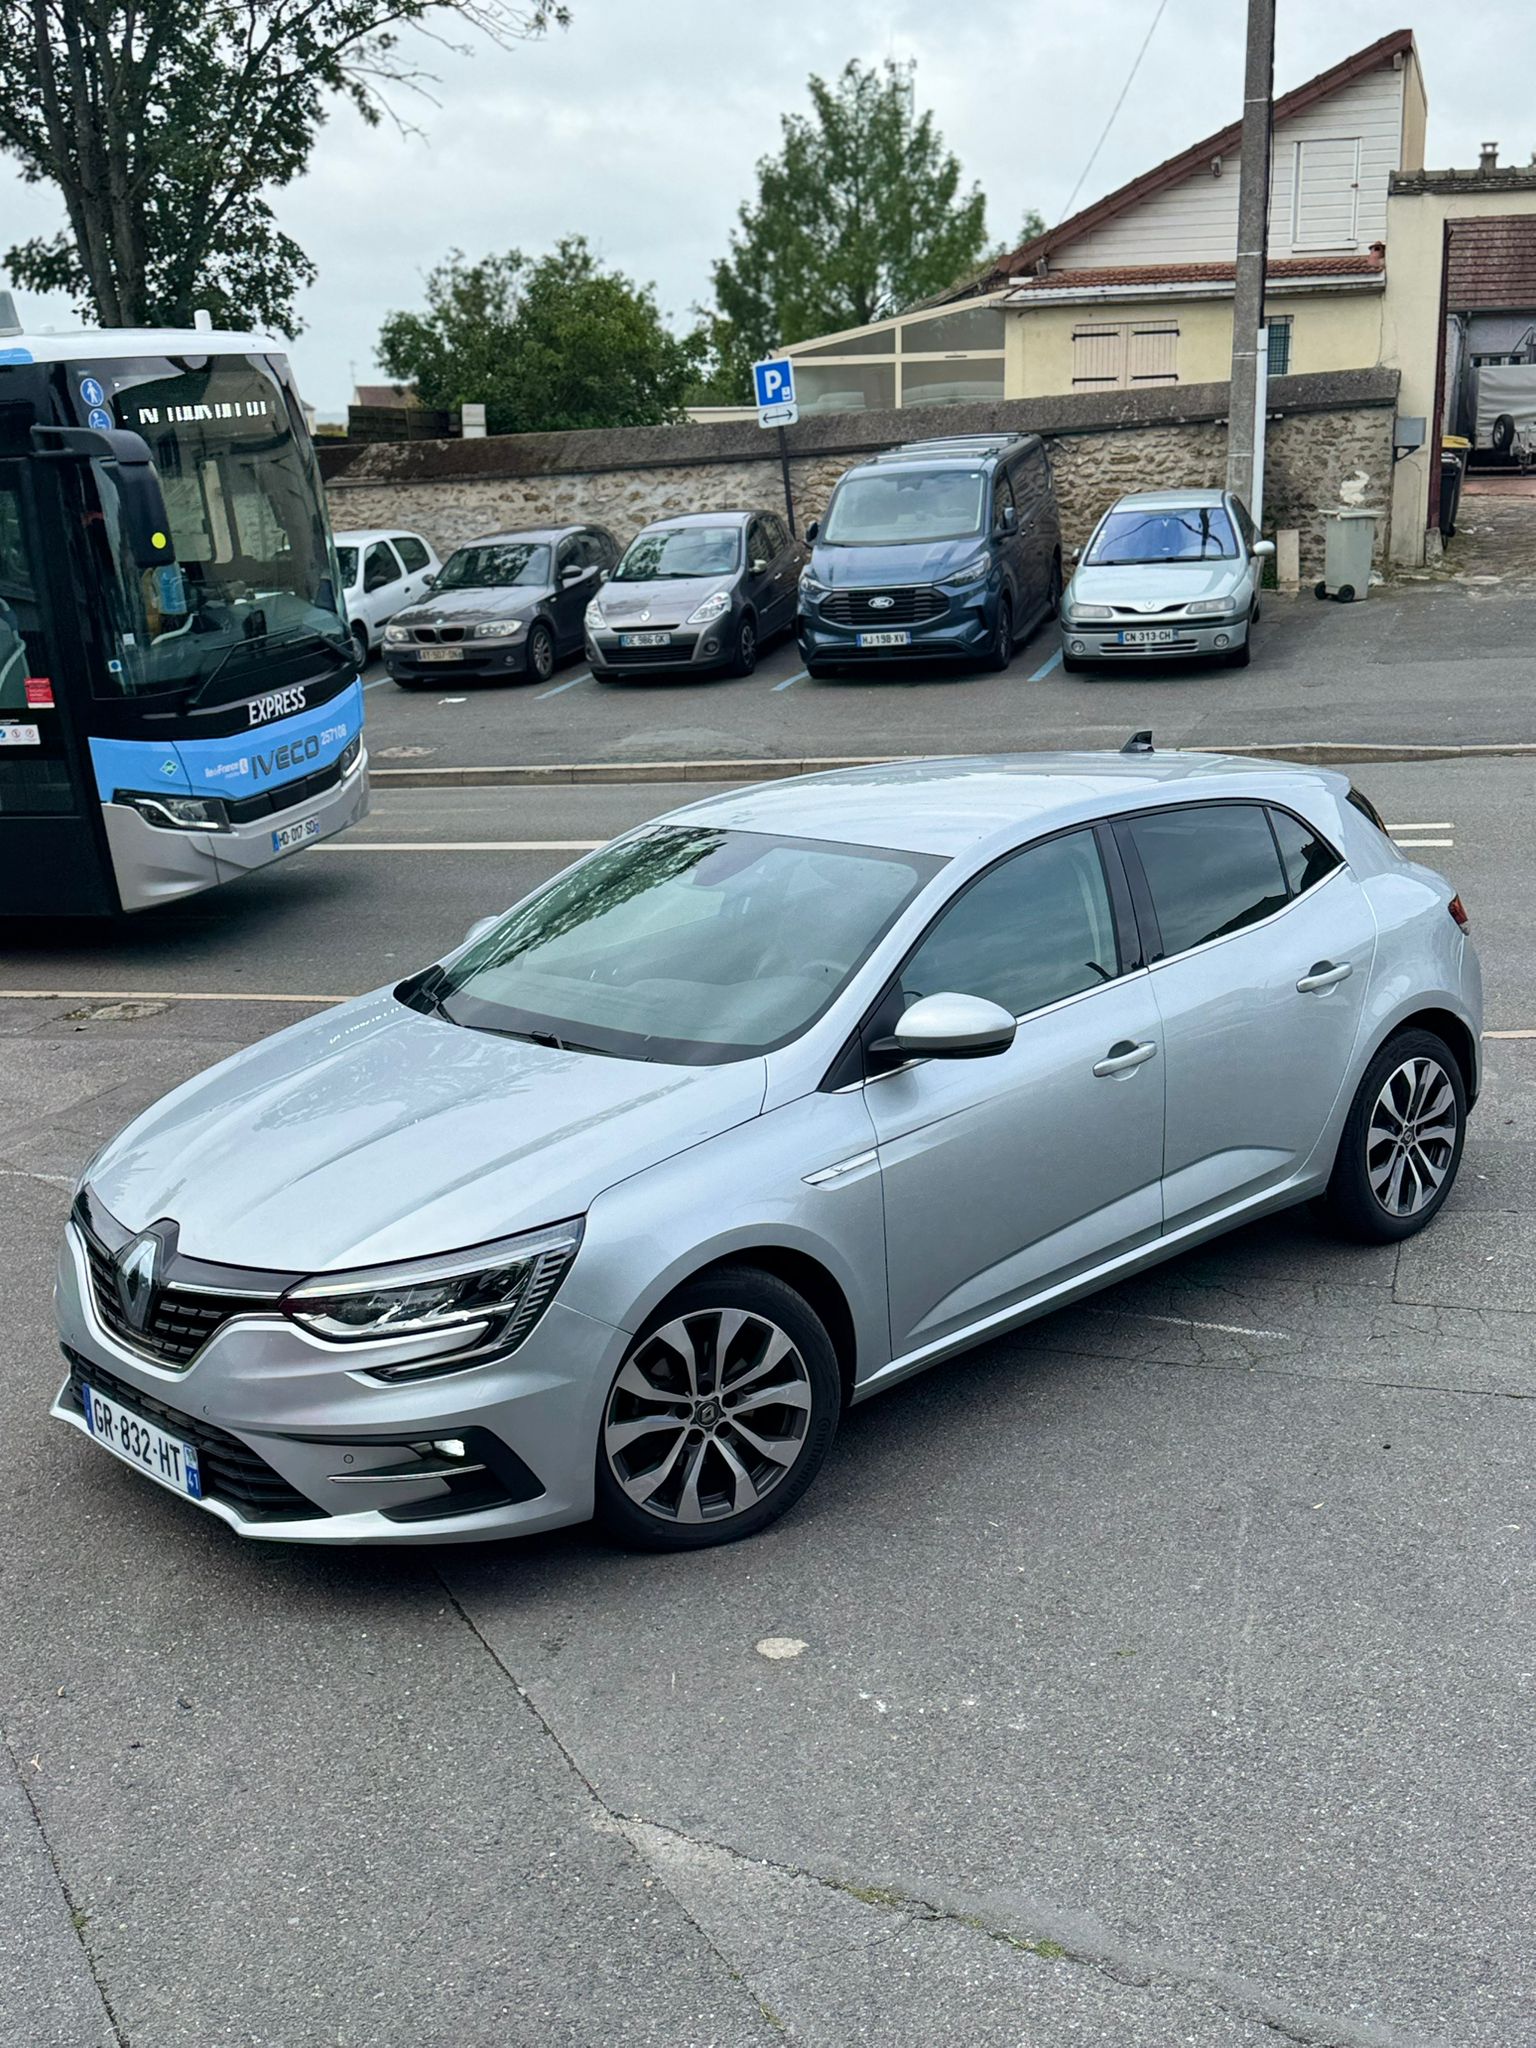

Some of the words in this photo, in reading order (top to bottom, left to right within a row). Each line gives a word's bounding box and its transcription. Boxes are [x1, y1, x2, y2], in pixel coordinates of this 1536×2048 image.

[764, 369, 782, 399] P
[247, 685, 306, 726] EXPRESS
[251, 735, 320, 779] IVECO
[94, 1398, 181, 1482] GR-832-HT
[188, 1470, 199, 1490] 41
